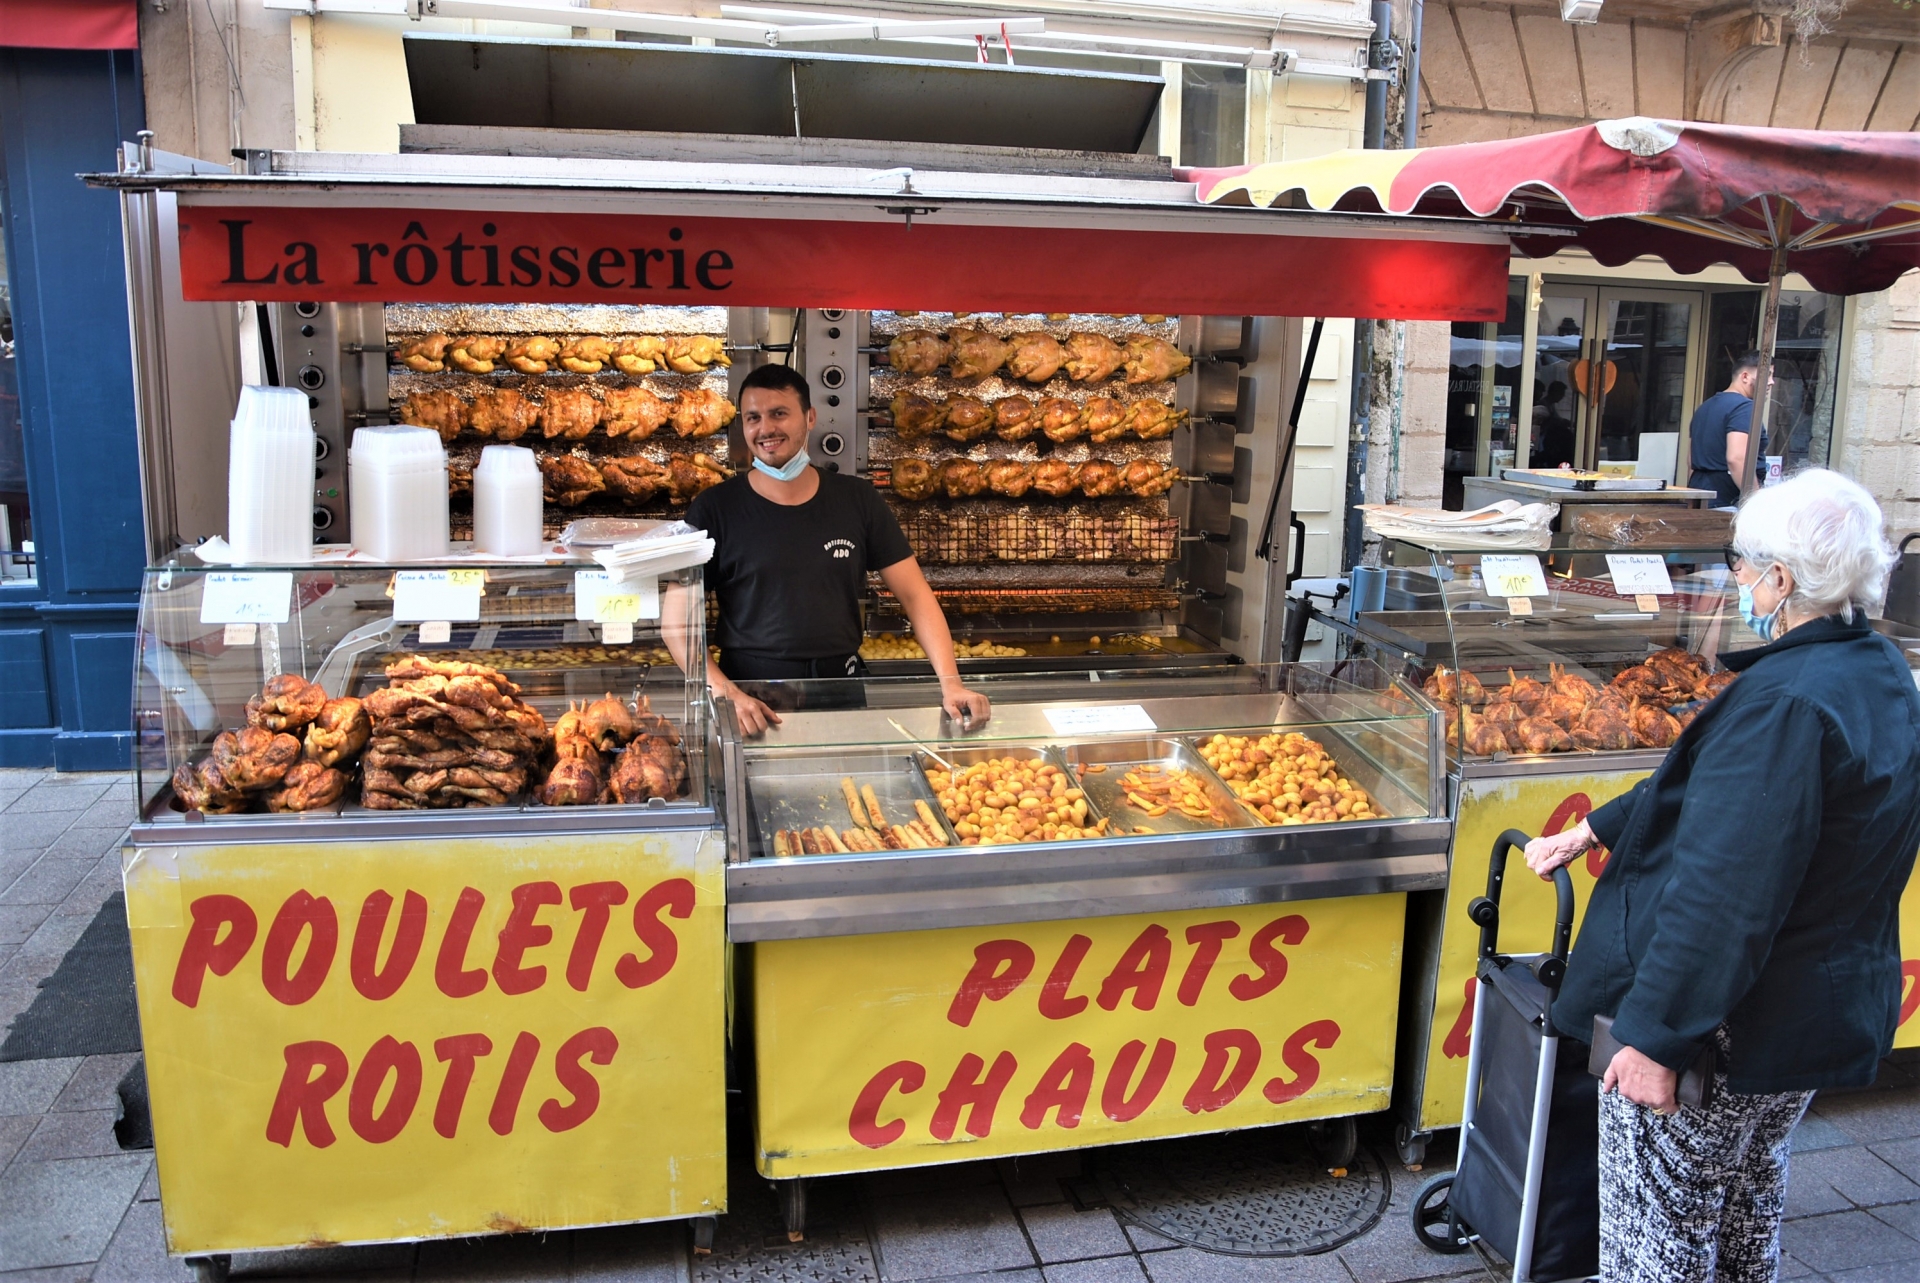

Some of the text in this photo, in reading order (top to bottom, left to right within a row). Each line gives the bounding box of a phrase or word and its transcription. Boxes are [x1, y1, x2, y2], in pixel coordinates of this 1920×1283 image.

[219, 219, 734, 292] La rôtisserie
[823, 538, 855, 551] ROTISSERIE
[833, 548, 850, 558] ADO
[171, 878, 696, 1009] POULETS
[947, 915, 1310, 1028] PLATS
[266, 1026, 619, 1149] ROTIS
[848, 1019, 1341, 1149] CHAUDS
